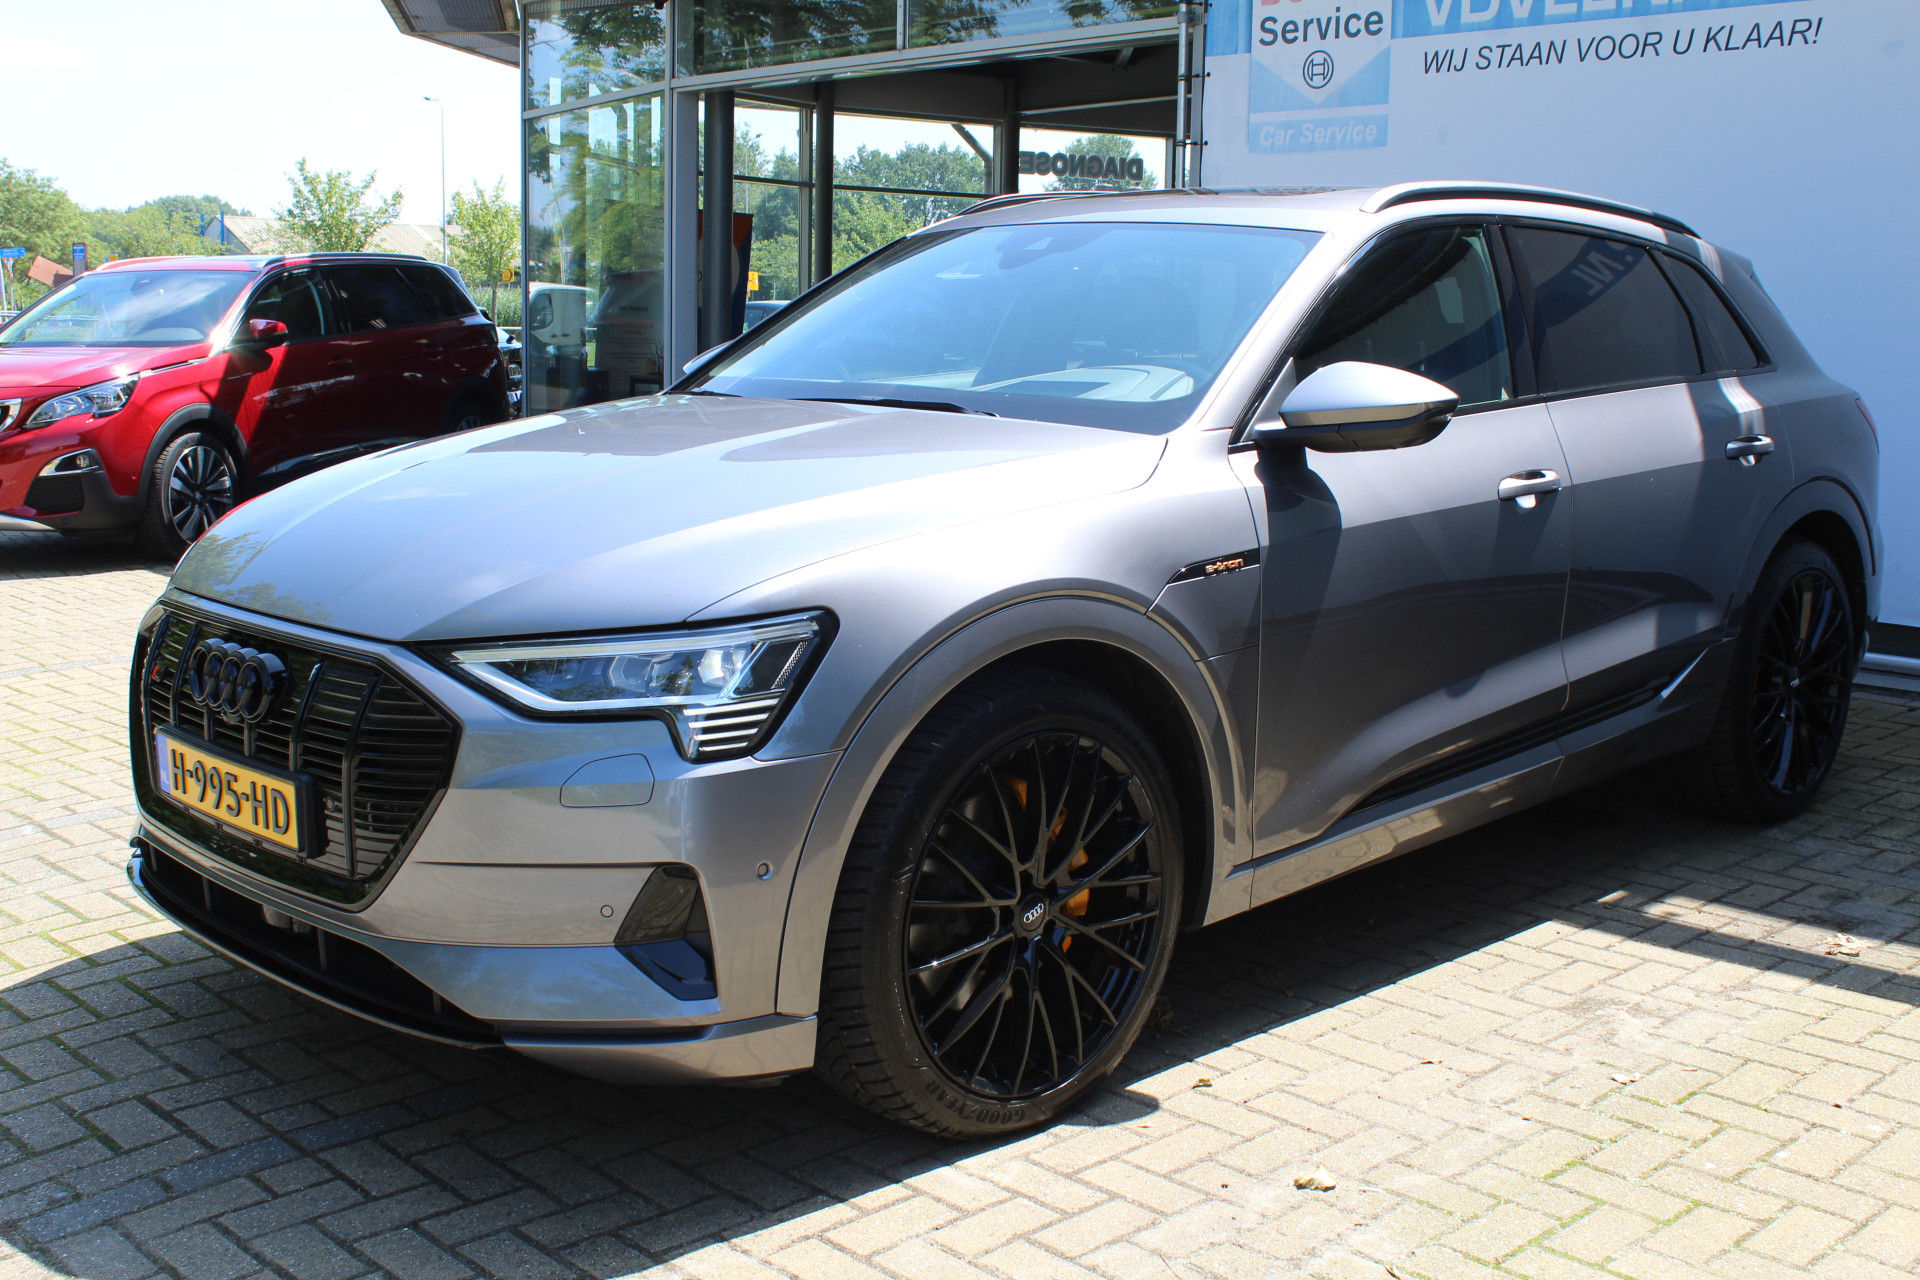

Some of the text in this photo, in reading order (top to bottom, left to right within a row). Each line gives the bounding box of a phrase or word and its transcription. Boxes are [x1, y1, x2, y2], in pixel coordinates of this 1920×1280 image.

[1259, 6, 1384, 46] Service
[1424, 16, 1824, 75] WIJ STAAN VOOR U KLAAR!
[1260, 120, 1378, 146] Car Service
[170, 748, 291, 835] H-995-HD
[925, 1080, 1026, 1125] GOODYEAR
